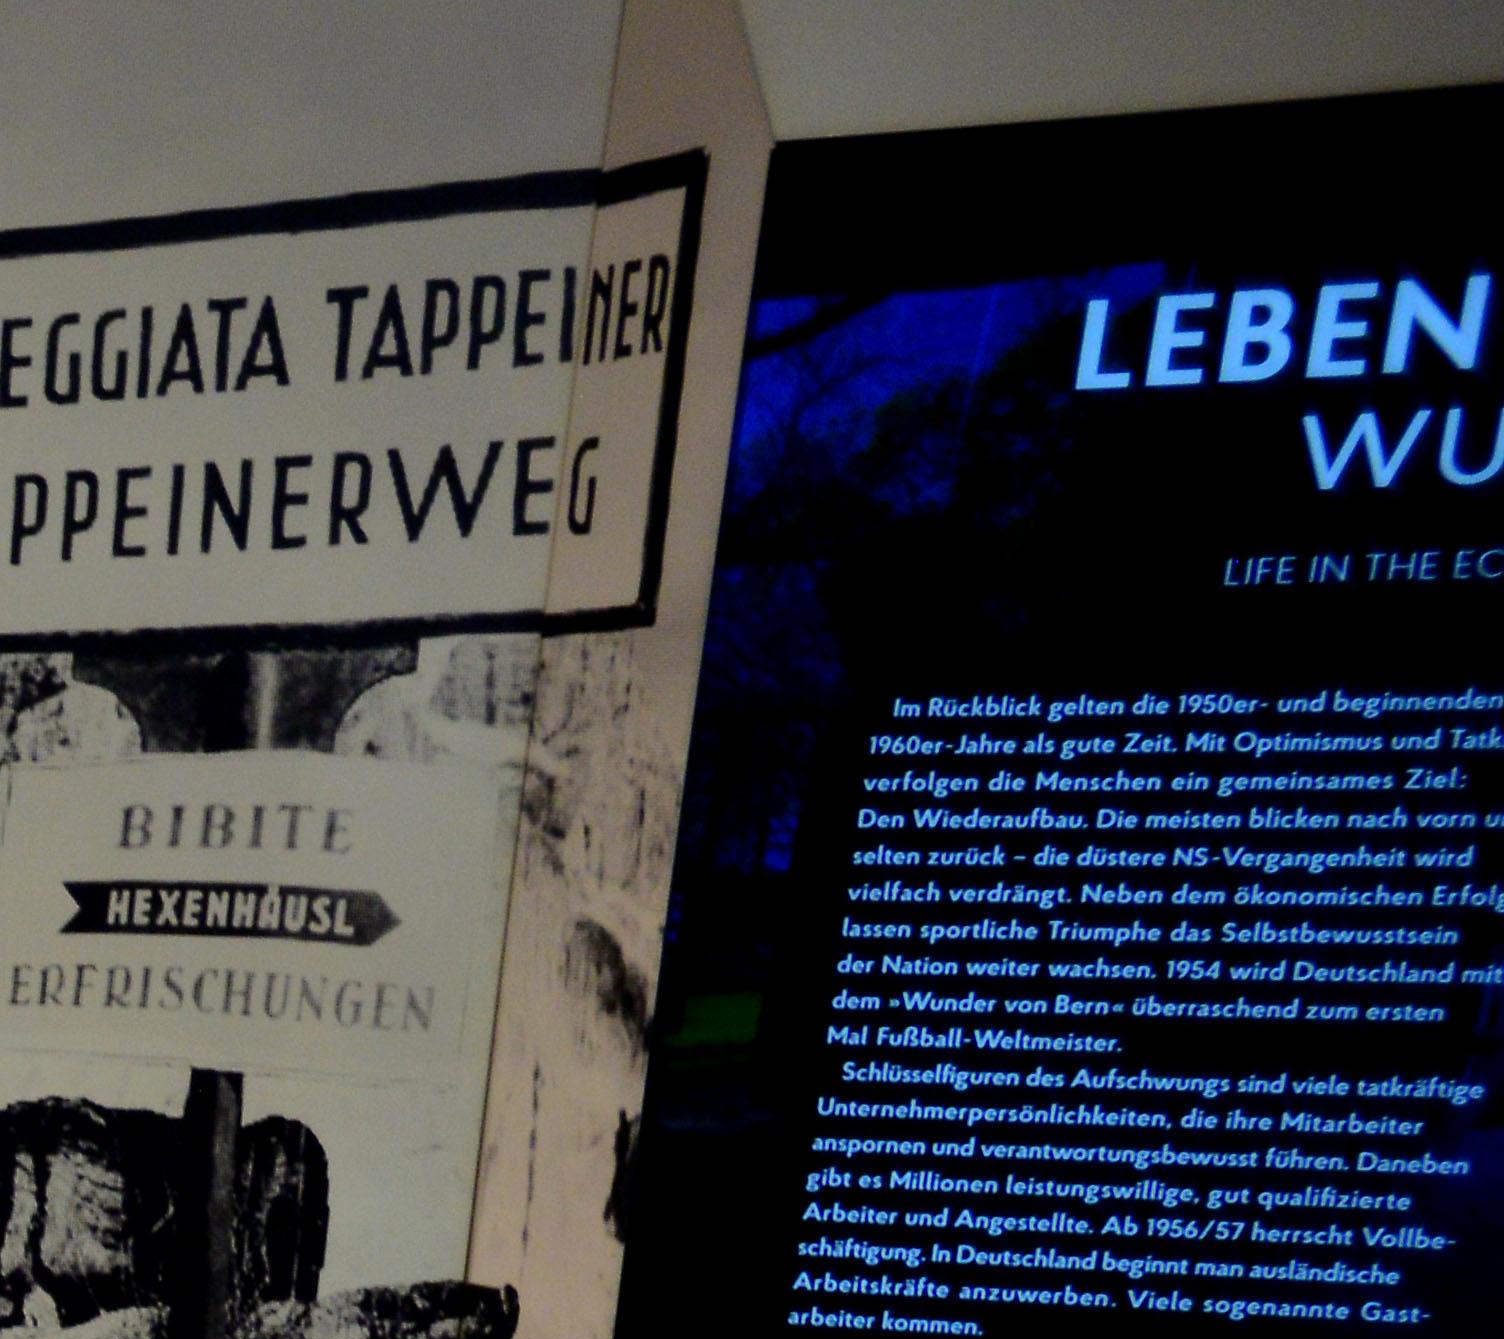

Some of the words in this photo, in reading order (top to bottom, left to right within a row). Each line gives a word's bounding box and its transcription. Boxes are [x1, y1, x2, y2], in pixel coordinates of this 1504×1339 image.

[327, 254, 671, 382] TAPPEINER
[1075, 273, 1491, 390] LEBEN
[1303, 407, 1504, 490] WU
[1224, 556, 1296, 585] LIFE
[1309, 555, 1349, 582] IN
[1367, 552, 1439, 580] THE
[892, 697, 922, 718] Im
[927, 694, 1042, 718] Rückblick
[1047, 693, 1126, 723] gelten
[1131, 692, 1171, 716] die
[1178, 693, 1268, 715] 1950er-
[1276, 690, 1328, 713] und
[1332, 687, 1504, 719] beginnenden
[870, 732, 1018, 756] 1960er-Jahre
[1022, 731, 1056, 755] als
[1060, 736, 1117, 761] gute
[1122, 731, 1178, 754] Zeit.
[1184, 731, 1227, 753] Mit
[1232, 730, 1384, 759] Optimismus
[1390, 727, 1443, 751] und
[863, 769, 980, 799] verfolgen
[987, 770, 1027, 792] die
[1034, 769, 1163, 792] Menschen
[1170, 771, 1211, 791] ein
[1216, 770, 1395, 798] gemeinsames
[1403, 766, 1467, 790] Ziel:
[120, 804, 353, 855] BIBITE
[857, 807, 906, 829] Den
[913, 806, 1089, 830] Wiederaufbau.
[1095, 807, 1139, 830] Die
[1144, 809, 1243, 830] meisten
[1248, 806, 1341, 830] blicken
[1346, 806, 1409, 829] nach
[1416, 813, 1477, 829] vorn
[1484, 814, 1504, 828] u
[852, 843, 921, 866] selten
[927, 844, 1006, 867] zurück
[1032, 844, 1071, 867] die
[1075, 844, 1167, 867] düstere
[1172, 845, 1408, 875] NS-Vergangenheit
[1414, 844, 1475, 868] wird
[847, 879, 942, 903] vielfach
[948, 881, 1072, 910] verdrängt.
[1080, 882, 1165, 905] Neben
[1170, 882, 1227, 905] dem
[1233, 883, 1425, 907] ökonomischen
[841, 916, 913, 939] lassen
[919, 918, 1039, 945] sportliche
[1048, 919, 1163, 948] Triumphe
[1169, 920, 1212, 943] das
[1221, 921, 1459, 945] Selbstbewusstsein
[836, 952, 876, 974] der
[881, 954, 959, 976] Nation
[965, 957, 1041, 978] weiter
[1047, 956, 1157, 980] wachsen.
[1167, 959, 1222, 980] 1954
[1229, 959, 1288, 982] wird
[1292, 960, 1456, 984] Deutschland
[1461, 964, 1504, 985] mit
[7, 962, 437, 1032] ERFRISCHUNGEN
[831, 988, 881, 1011] dem
[1004, 999, 1049, 1014] von
[1131, 994, 1300, 1020] überraschend
[1304, 1005, 1360, 1020] zum
[1364, 1004, 1445, 1022] ersten
[826, 1024, 869, 1046] Mal
[876, 1025, 1123, 1053] Fußball-Weltmeister.
[841, 1060, 1021, 1092] Schlüsselfiguren
[1025, 1065, 1066, 1088] des
[1069, 1067, 1231, 1099] Aufschwungs
[1237, 1072, 1288, 1095] sind
[1291, 1073, 1351, 1097] viele
[1356, 1075, 1486, 1106] tatkräftige
[816, 1096, 1173, 1130] Unternehmerpersönlichkeiten,
[1180, 1107, 1219, 1130] die
[1225, 1108, 1274, 1132] ihre
[1279, 1111, 1425, 1136] Mitarbeiter
[811, 1137, 927, 1159] anspornen
[931, 1136, 977, 1158] und
[980, 1143, 1260, 1171] verantwortungsbewusst
[1264, 1146, 1350, 1171] führen.
[1356, 1151, 1471, 1175] Daneben
[805, 1166, 852, 1193] gibt
[857, 1174, 883, 1190] es
[888, 1170, 999, 1194] Millionen
[1005, 1173, 1200, 1209] leistungswillige,
[1206, 1188, 1251, 1210] gut
[1257, 1185, 1412, 1212] qualifizierte
[802, 1201, 899, 1225] Arbeiter
[904, 1207, 950, 1228] und
[953, 1208, 1094, 1237] Angestellte.
[1100, 1215, 1140, 1237] Ab
[1147, 1217, 1246, 1241] 1956/57
[1250, 1220, 1354, 1246] herrscht
[1362, 1226, 1456, 1250] Vollbe-
[798, 1236, 927, 1269] schäftigung.
[930, 1242, 953, 1264] In
[955, 1243, 1099, 1271] Deutschland
[1101, 1250, 1190, 1280] beginnt
[1193, 1262, 1245, 1278] man
[1248, 1259, 1401, 1286] ausländische
[792, 1271, 950, 1299] Arbeitskräfte
[958, 1284, 1117, 1308] anzuwerben.
[1127, 1289, 1194, 1312] Viele
[1203, 1299, 1351, 1321] sogenannte
[1360, 1300, 1430, 1324] Gast-
[787, 1305, 876, 1330] arbeiter
[881, 1309, 983, 1337] kommen.
